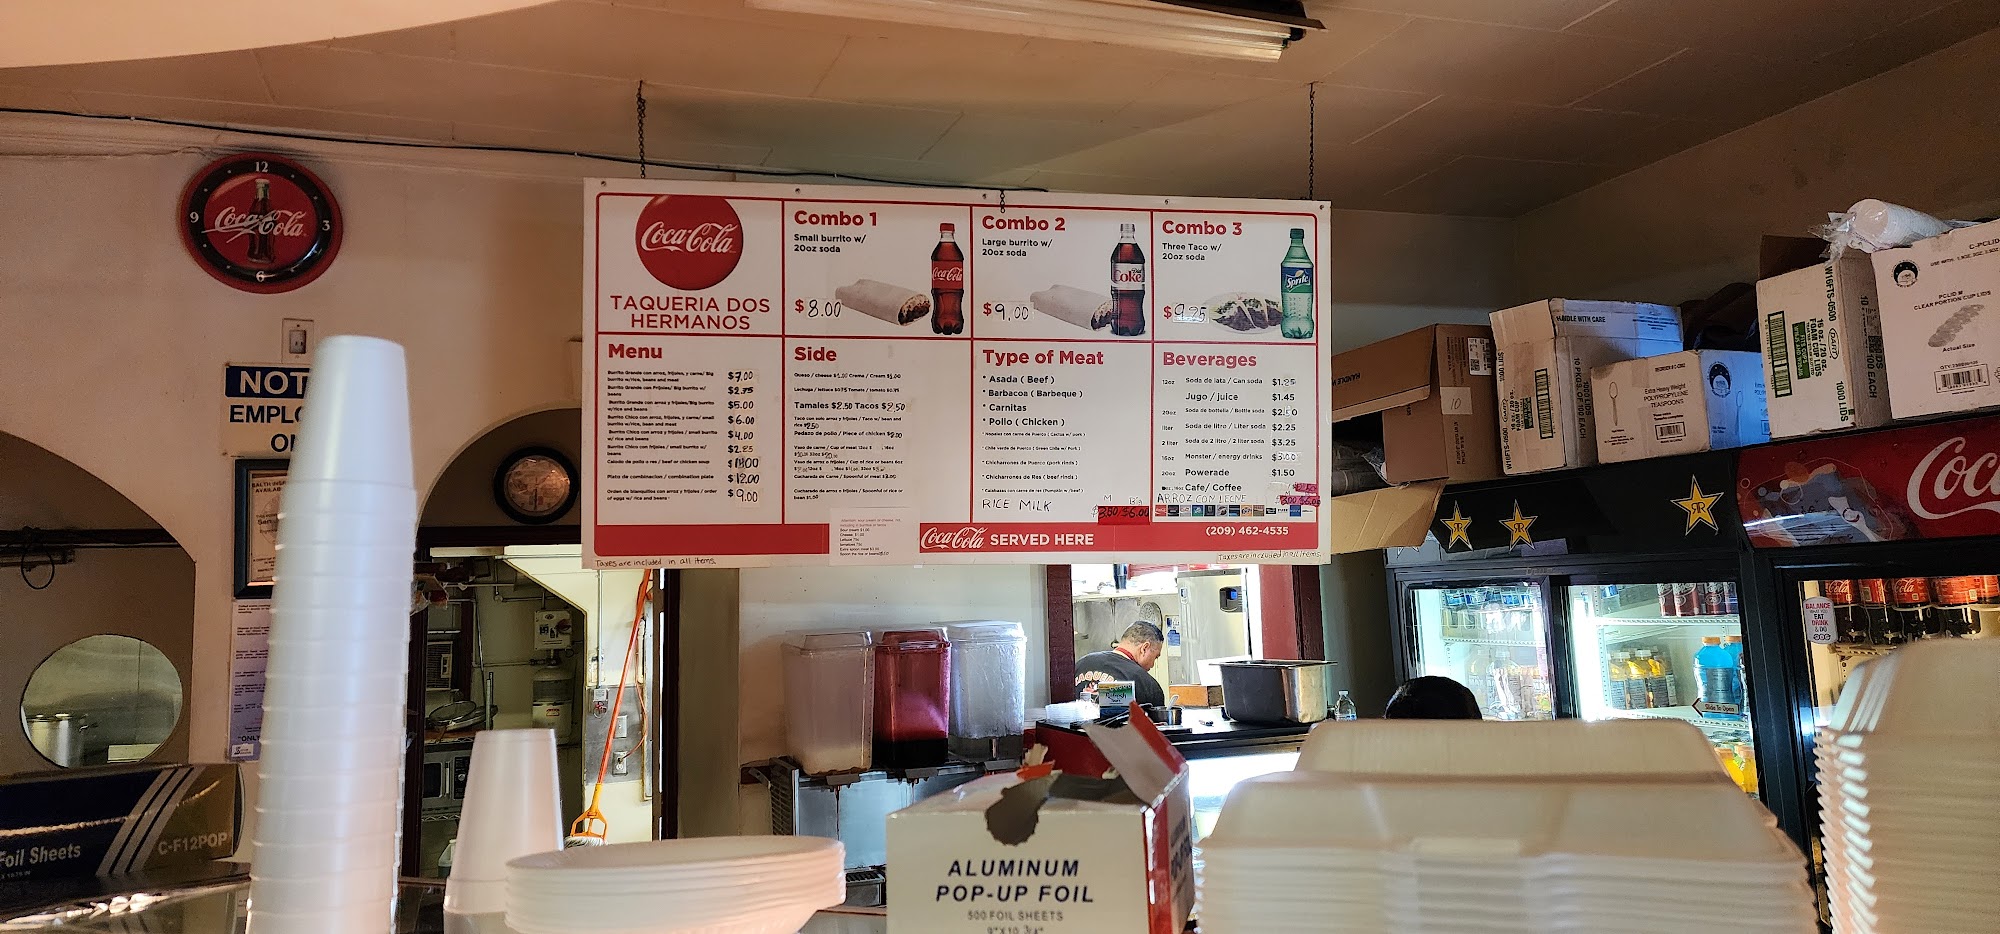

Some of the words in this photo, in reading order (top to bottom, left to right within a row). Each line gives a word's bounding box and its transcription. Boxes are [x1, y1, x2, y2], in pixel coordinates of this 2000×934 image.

[255, 161, 268, 172] 12
[190, 212, 199, 223] 9
[203, 206, 306, 240] Coca-Cola
[794, 211, 864, 226] Combo
[869, 212, 877, 226] 1
[982, 215, 1049, 230] Combo
[1054, 217, 1066, 231] 2
[322, 221, 330, 231] 3
[1163, 221, 1227, 235] Combo
[1232, 222, 1242, 235] 3
[641, 221, 737, 253] Coca-Cola
[821, 235, 851, 243] burrito
[854, 235, 866, 243] w/
[1009, 239, 1038, 247] burrito
[1041, 239, 1052, 248] w/
[794, 244, 817, 252] 20oz
[1211, 244, 1222, 252] w/
[256, 271, 265, 282] 6
[932, 266, 962, 281] Coca-Cola
[1286, 275, 1309, 289] Sprite
[1935, 297, 1962, 306] PORTION
[1939, 291, 1957, 299] PCLID
[610, 296, 719, 312] TAQUERIA
[727, 298, 770, 313] DOS
[631, 314, 750, 330] HERMANOS
[608, 344, 662, 359] Menu
[794, 347, 837, 361] Side
[983, 350, 1029, 366] Type
[1035, 350, 1054, 364] of
[1059, 351, 1103, 365] Meat
[1163, 352, 1257, 368] Beverages
[1814, 359, 1822, 377] LIDS
[240, 371, 309, 394] NOT
[728, 371, 753, 382] $7.00
[1582, 381, 1591, 402] 1000
[1836, 381, 1845, 401] 1000
[1868, 372, 1877, 398] EACH
[1037, 390, 1077, 398] Barbeque
[1186, 393, 1207, 401] Jugo
[1217, 392, 1238, 401] juice
[728, 401, 753, 409] $5.00
[989, 404, 1027, 412] Carnitas
[1450, 398, 1461, 409] 10
[1584, 403, 1592, 417] LIDS
[1650, 399, 1684, 408] TEASPOONS
[1839, 402, 1848, 421] LIDS
[728, 415, 754, 424] $6.00
[989, 418, 1012, 426] Pollo
[1579, 418, 1587, 439] EACH
[728, 431, 753, 440] $4.00
[1272, 469, 1295, 477] $1.50
[1185, 484, 1210, 492] Cafe/
[1158, 493, 1193, 503] ARROZ
[1195, 494, 1216, 503] CON
[983, 499, 1011, 509] RICE
[1019, 500, 1052, 512] MILK
[1206, 527, 1236, 536] (209)
[1239, 527, 1289, 535] 462-4535
[921, 527, 988, 550] Coca-Cola
[990, 534, 1050, 545] SERVED
[1055, 534, 1094, 545] HERE
[596, 559, 617, 567] Taxes
[157, 832, 228, 855] C-F12POP
[29, 842, 81, 864] Sheets
[948, 860, 1079, 877] ALUMINUM
[936, 885, 1028, 903] POP-UP
[1038, 885, 1093, 903] FOIL
[968, 910, 987, 921] 500
[989, 910, 1014, 921] FOIL
[1018, 911, 1064, 922] SHEETS
